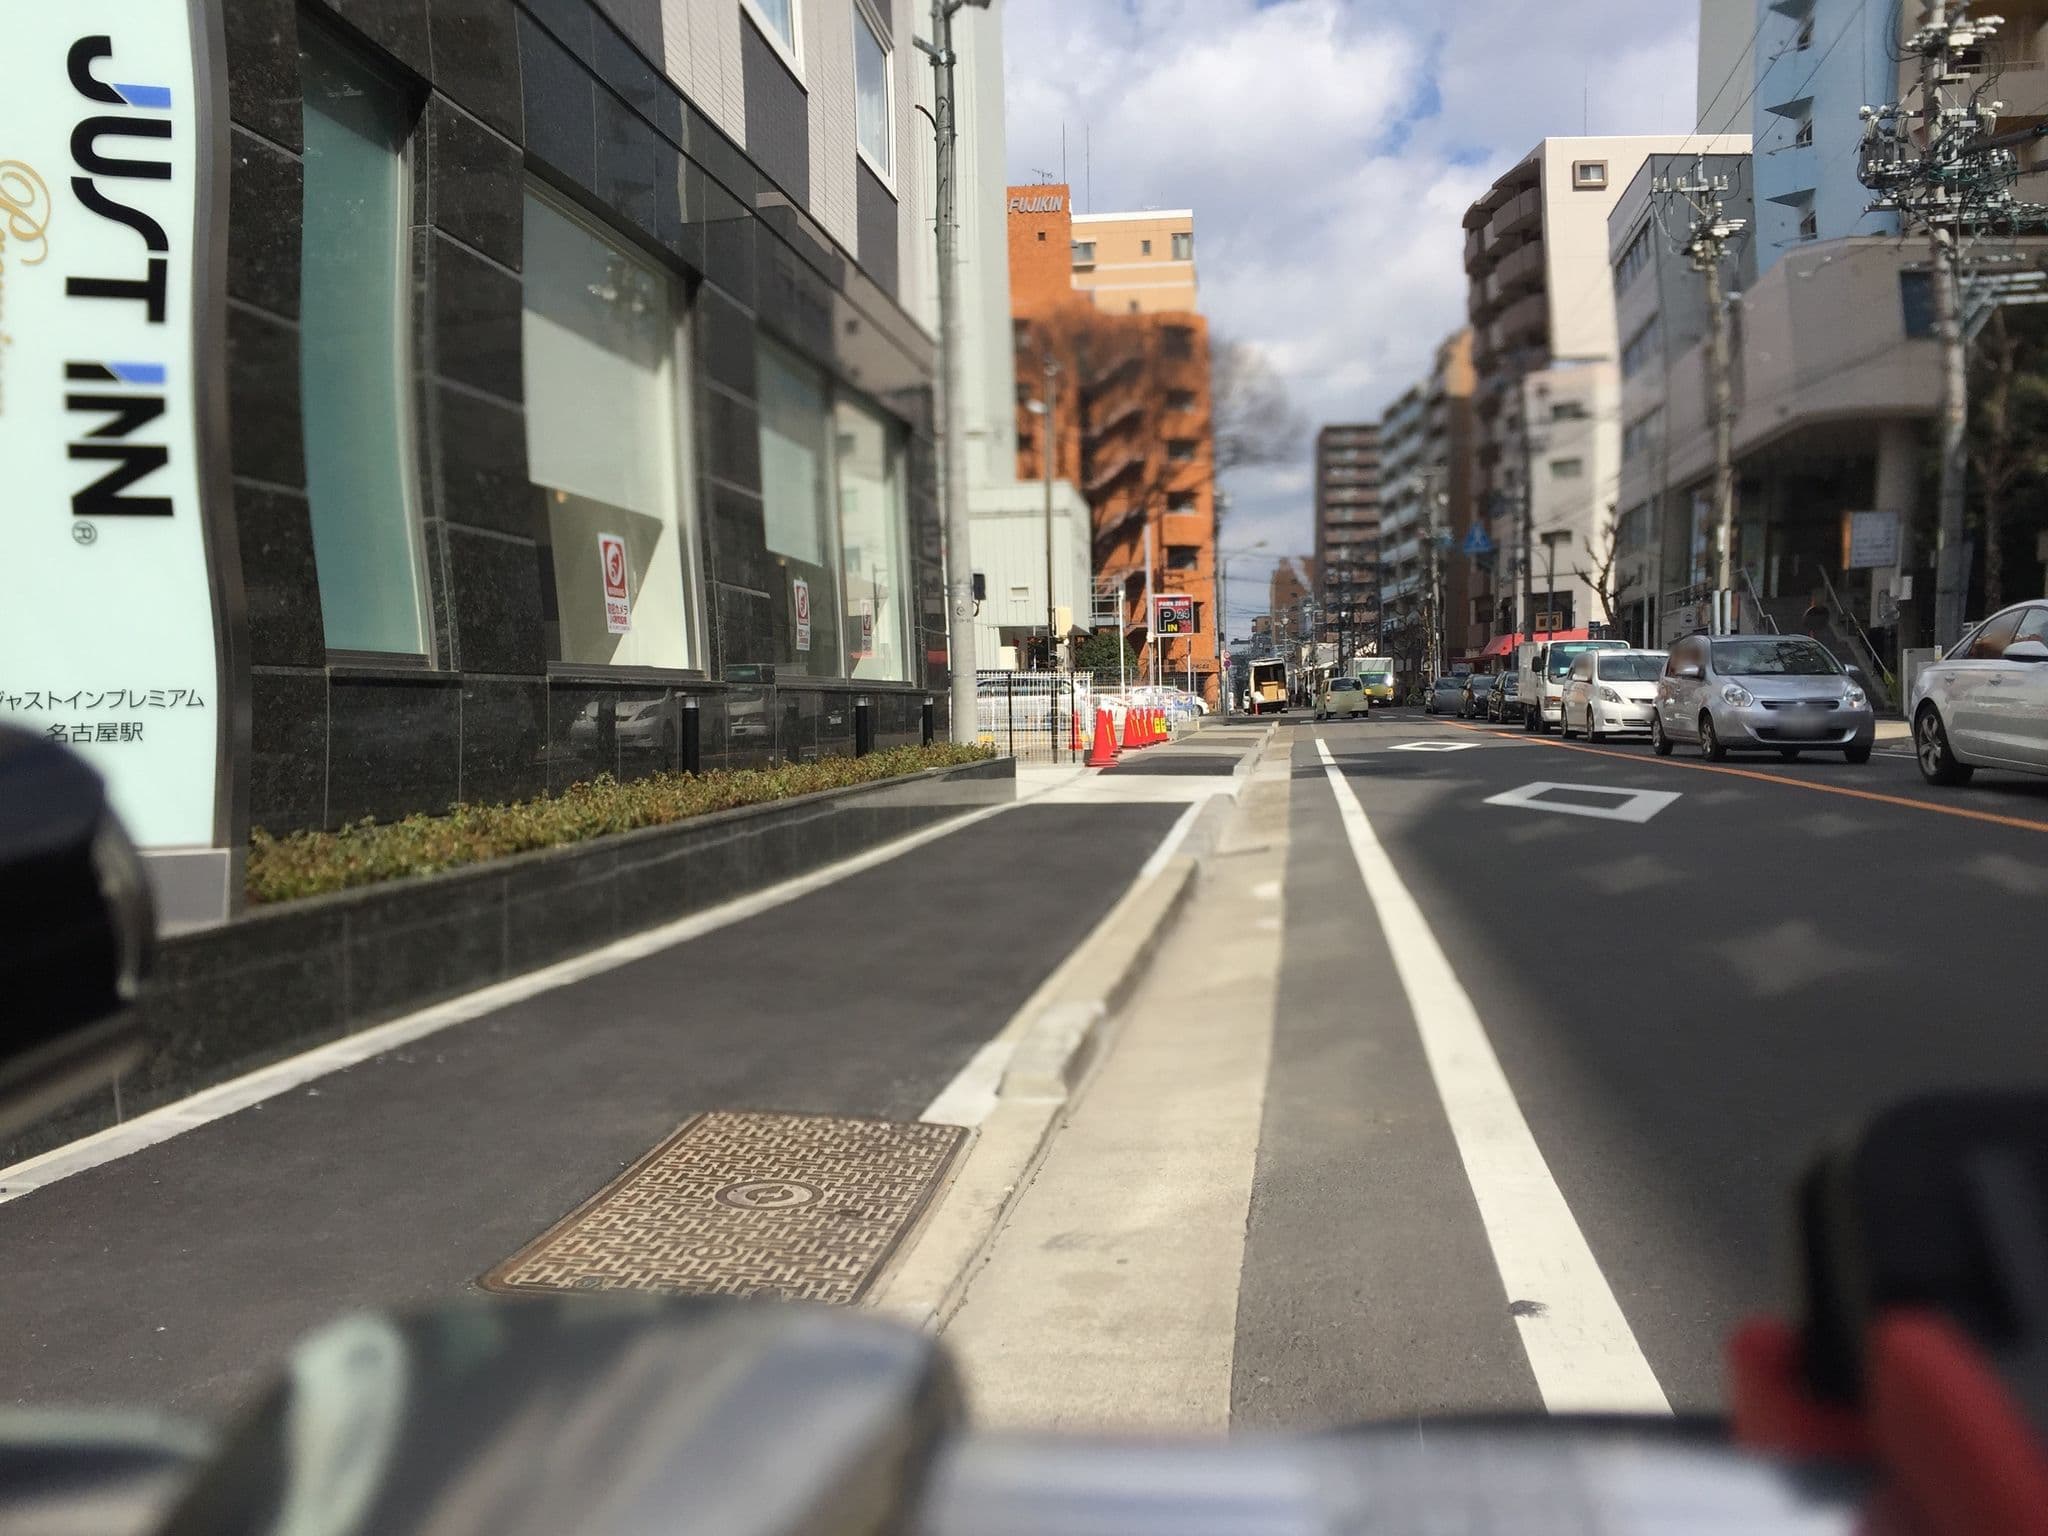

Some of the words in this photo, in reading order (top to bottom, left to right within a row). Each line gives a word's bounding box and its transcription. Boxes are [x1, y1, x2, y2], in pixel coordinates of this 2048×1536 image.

[66, 35, 172, 324] JUST
[1008, 196, 1063, 213] FUJIKIN
[64, 361, 174, 516] INN
[1159, 607, 1177, 632] P
[1167, 624, 1178, 632] IN
[46, 722, 144, 744] 名古屋駅
